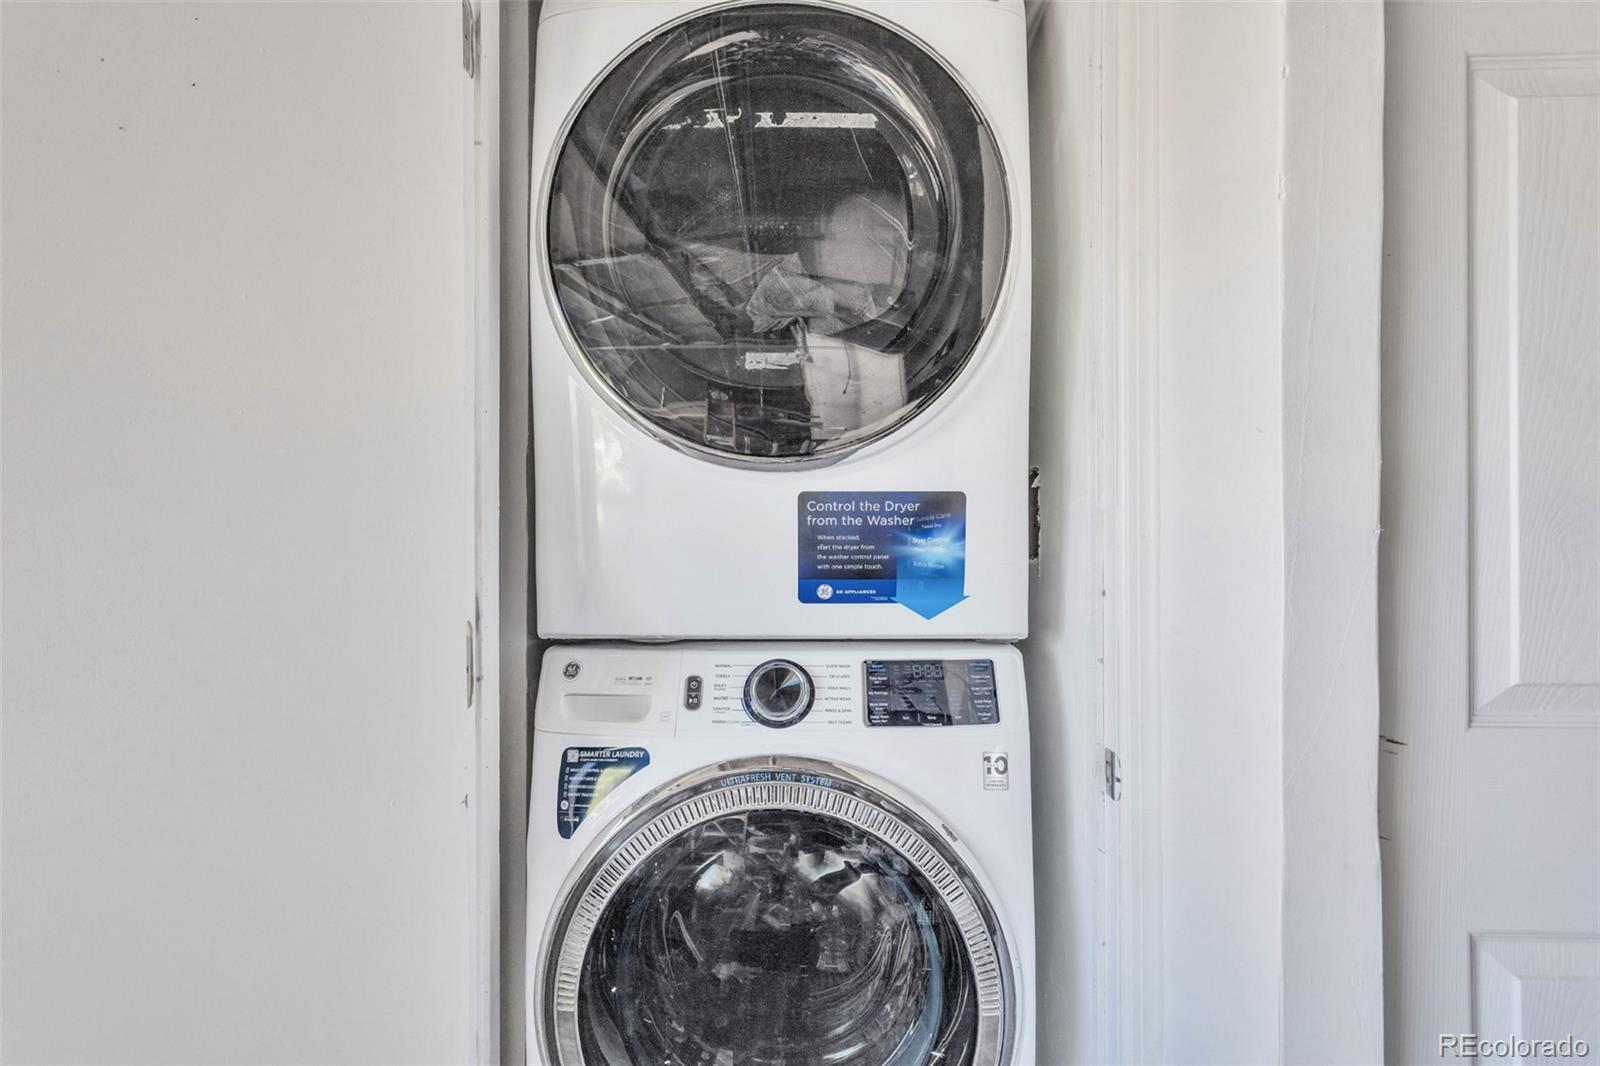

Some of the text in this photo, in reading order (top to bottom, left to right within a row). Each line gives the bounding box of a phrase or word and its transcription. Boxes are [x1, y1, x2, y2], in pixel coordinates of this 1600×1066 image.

[806, 501, 920, 514] Control the Dryer
[806, 515, 914, 526] from the Washer
[984, 756, 1008, 775] 10
[720, 773, 833, 787] ULTRAFRESH VENT SYSTEM
